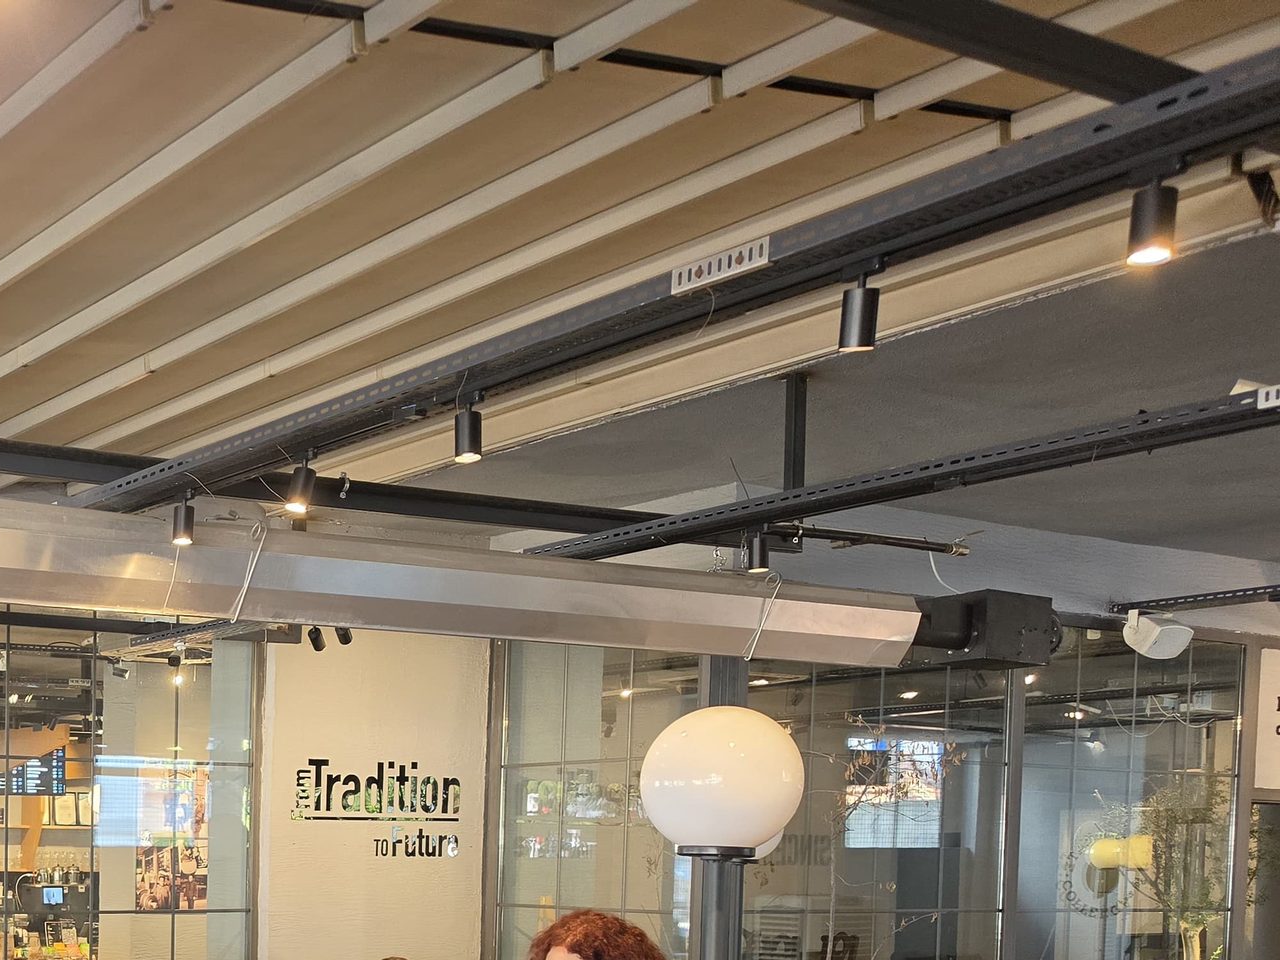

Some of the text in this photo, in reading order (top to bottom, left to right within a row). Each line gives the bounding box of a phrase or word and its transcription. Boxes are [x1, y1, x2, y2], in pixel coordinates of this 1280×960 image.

[308, 758, 461, 814] Tradition
[374, 826, 459, 858] TO Future
